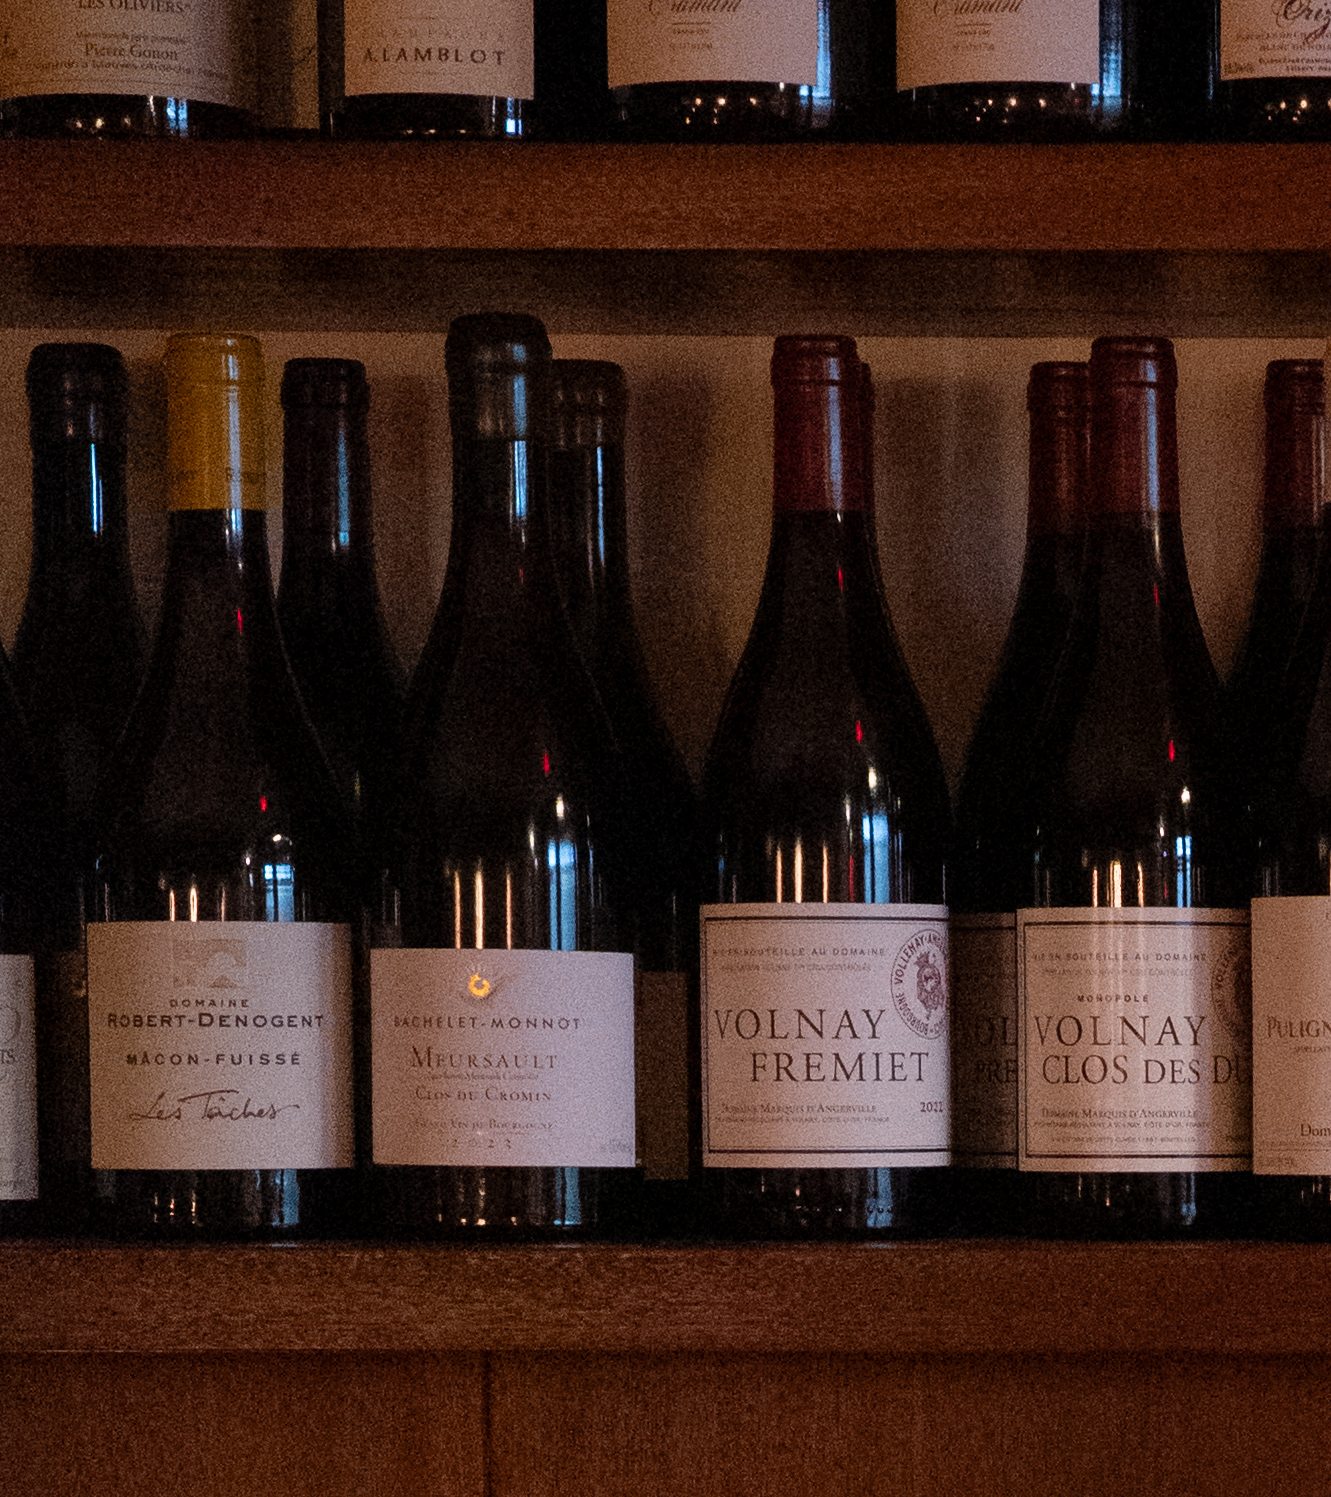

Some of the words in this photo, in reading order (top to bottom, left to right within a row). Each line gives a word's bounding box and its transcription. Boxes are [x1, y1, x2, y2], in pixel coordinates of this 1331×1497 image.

[85, 42, 125, 58] Pierre
[129, 44, 178, 60] Gonon
[812, 948, 825, 956] AU
[832, 947, 885, 956] DOMAINE
[1156, 953, 1207, 961] DOMAINE
[170, 999, 249, 1008] DOMAINE
[108, 1012, 324, 1028] ROBERT-DENOGENT
[394, 1016, 580, 1030] BACHELET-MONNOT
[714, 1008, 886, 1040] VOLNAY
[1034, 1015, 1207, 1046] VOLNAY
[126, 1053, 300, 1066] MÂCON-FUISSÉ
[411, 1045, 558, 1069] MEURSAULT
[750, 1052, 929, 1083] FREMIET
[1042, 1055, 1129, 1084] CLOS
[1144, 1059, 1200, 1084] DES
[485, 1086, 551, 1101] CROMIN
[129, 1092, 182, 1121] Les
[177, 1089, 300, 1121] Tâches
